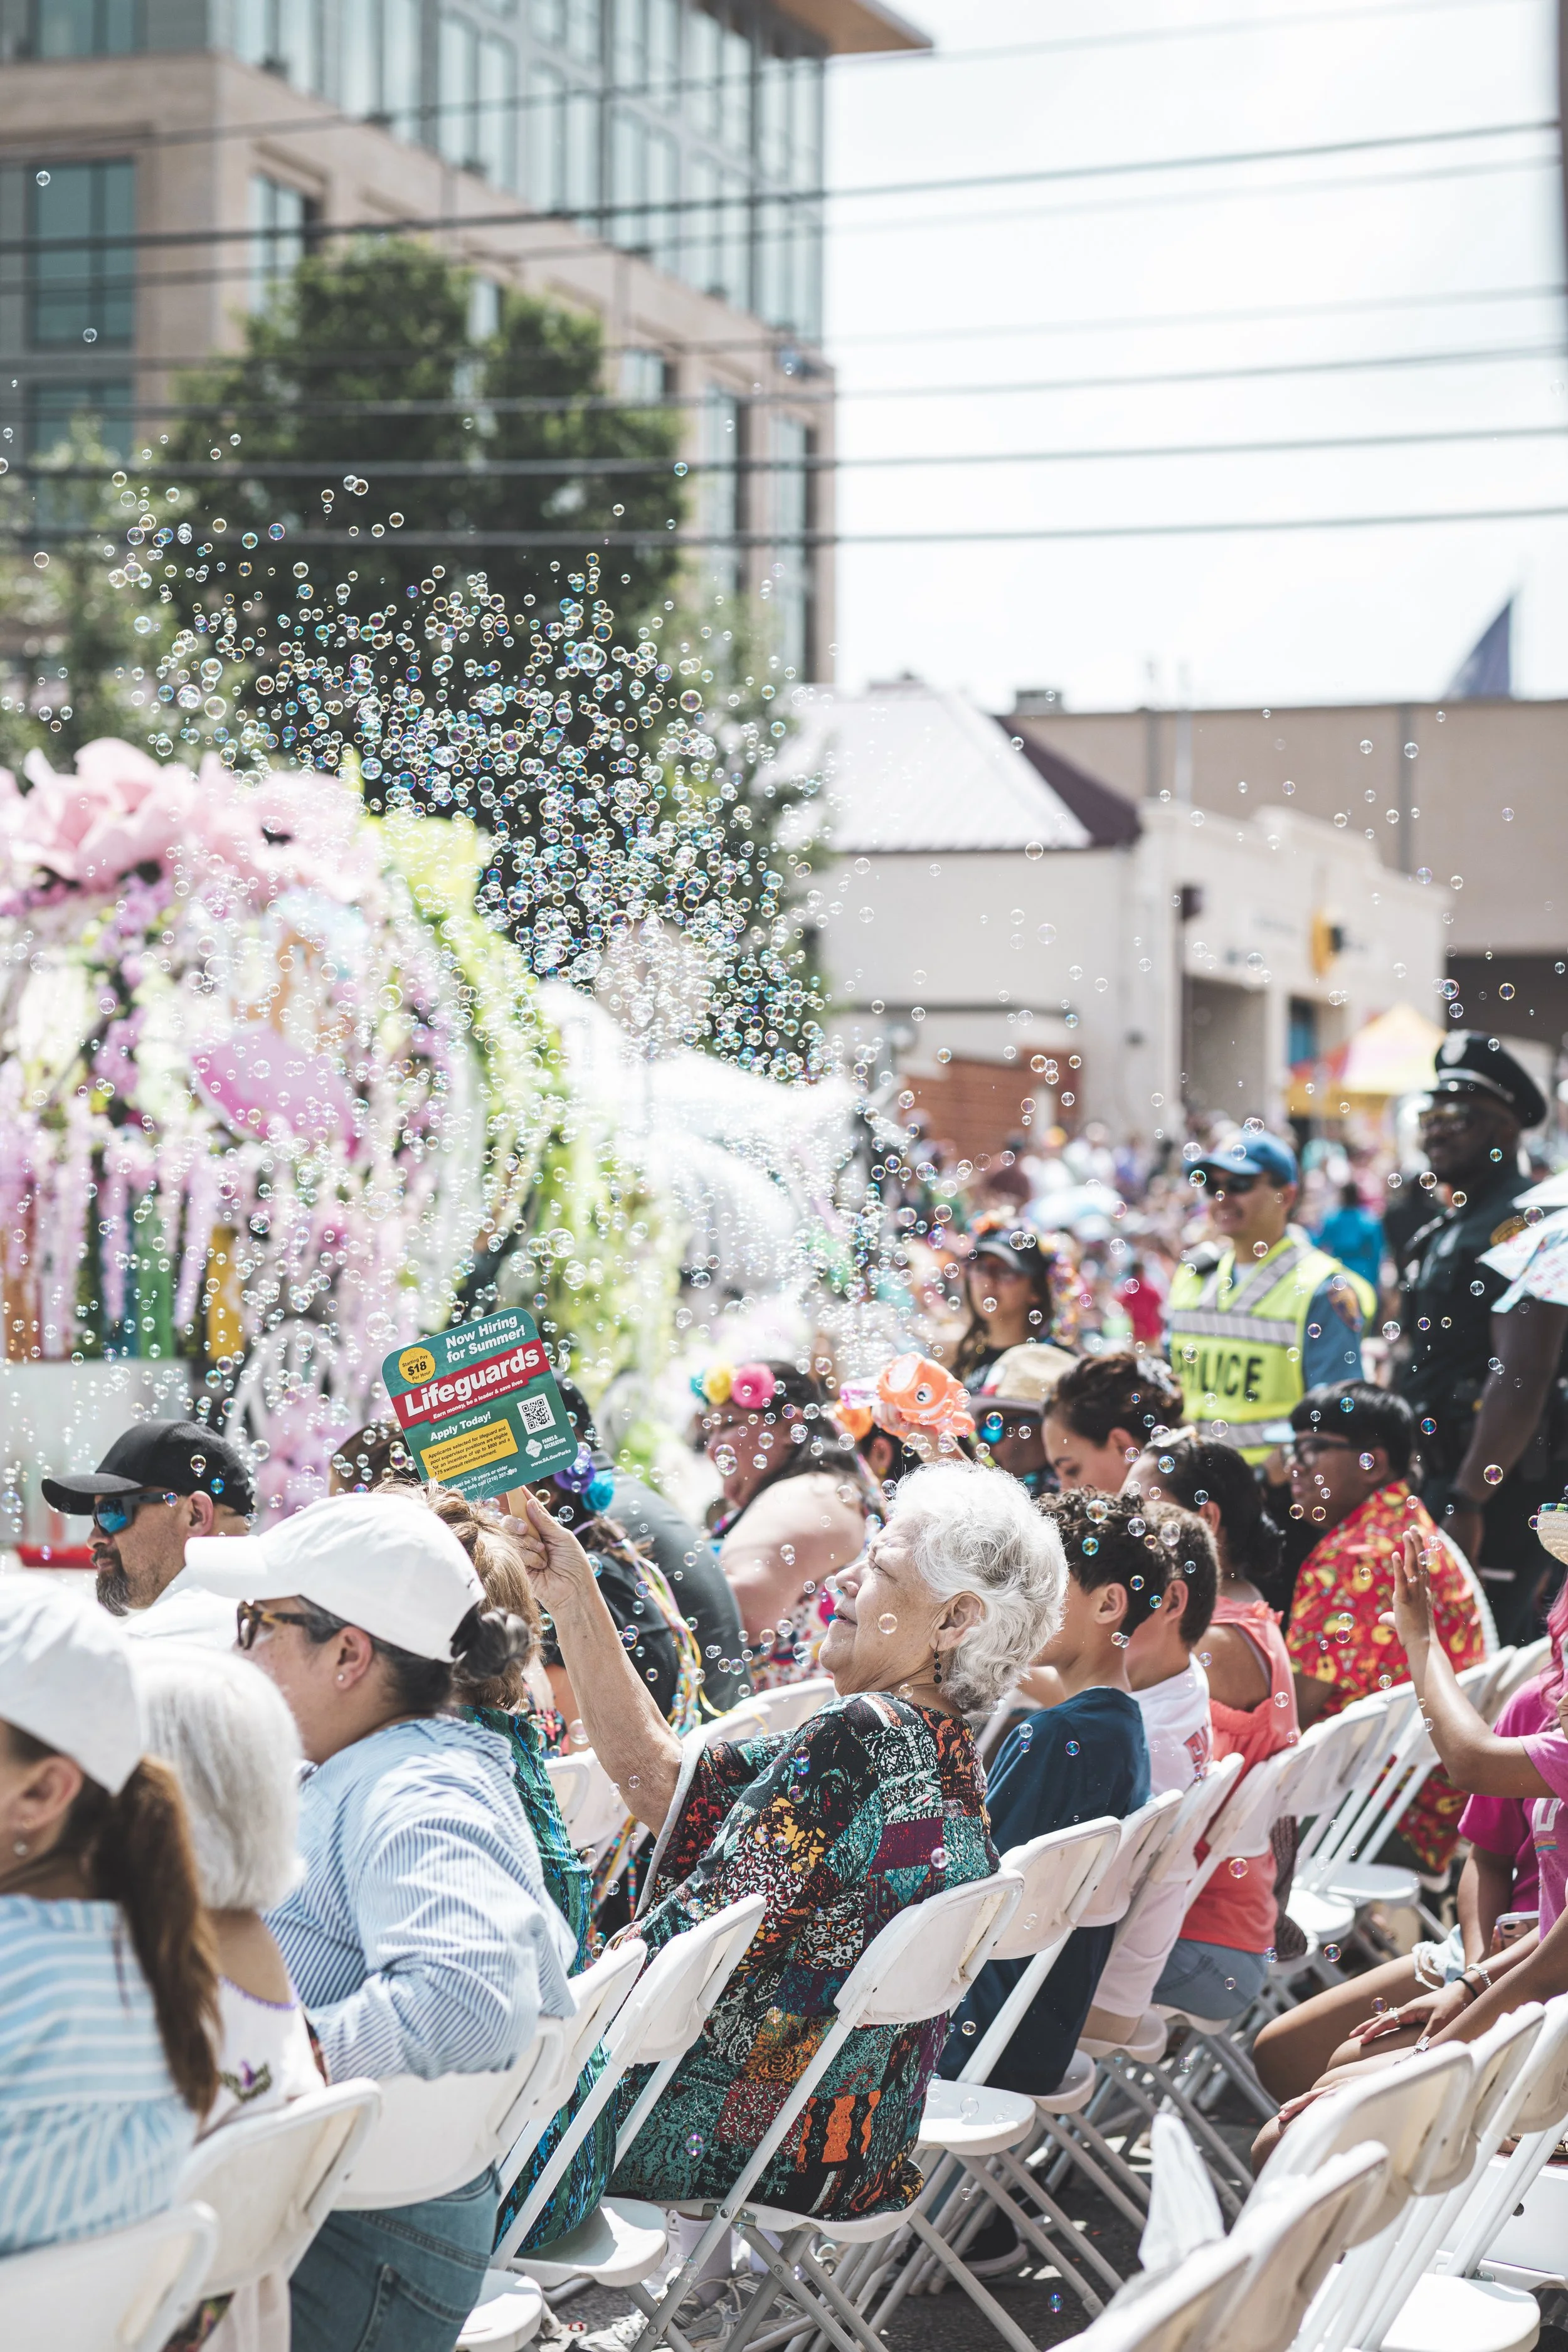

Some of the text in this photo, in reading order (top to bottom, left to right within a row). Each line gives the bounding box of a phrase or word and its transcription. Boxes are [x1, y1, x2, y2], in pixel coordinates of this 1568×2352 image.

[445, 1315, 517, 1348] Now Hiring
[446, 1324, 525, 1363] for Summer!
[402, 1358, 419, 1367] Starting
[408, 1360, 426, 1375] $18
[405, 1348, 540, 1417] Lifeguards
[447, 1403, 465, 1413] money,
[478, 1391, 494, 1400] leader
[499, 1384, 511, 1392] save
[511, 1379, 523, 1387] lives
[430, 1411, 491, 1441] Apply Today!
[428, 1447, 451, 1459] Applicants
[452, 1439, 470, 1449] selected
[479, 1429, 497, 1440] lifeguard
[430, 1456, 440, 1465] pool
[441, 1448, 464, 1460] supervisor
[465, 1440, 485, 1451] positions
[493, 1431, 508, 1440] eligible
[542, 1436, 554, 1444] PARKS
[543, 1437, 566, 1449] RECREATION
[447, 1454, 467, 1464] incentive
[487, 1441, 497, 1449] $800
[443, 1461, 463, 1473] swimsuit
[477, 1471, 490, 1481] years
[496, 1465, 507, 1473] older
[487, 1474, 498, 1483] (210)
